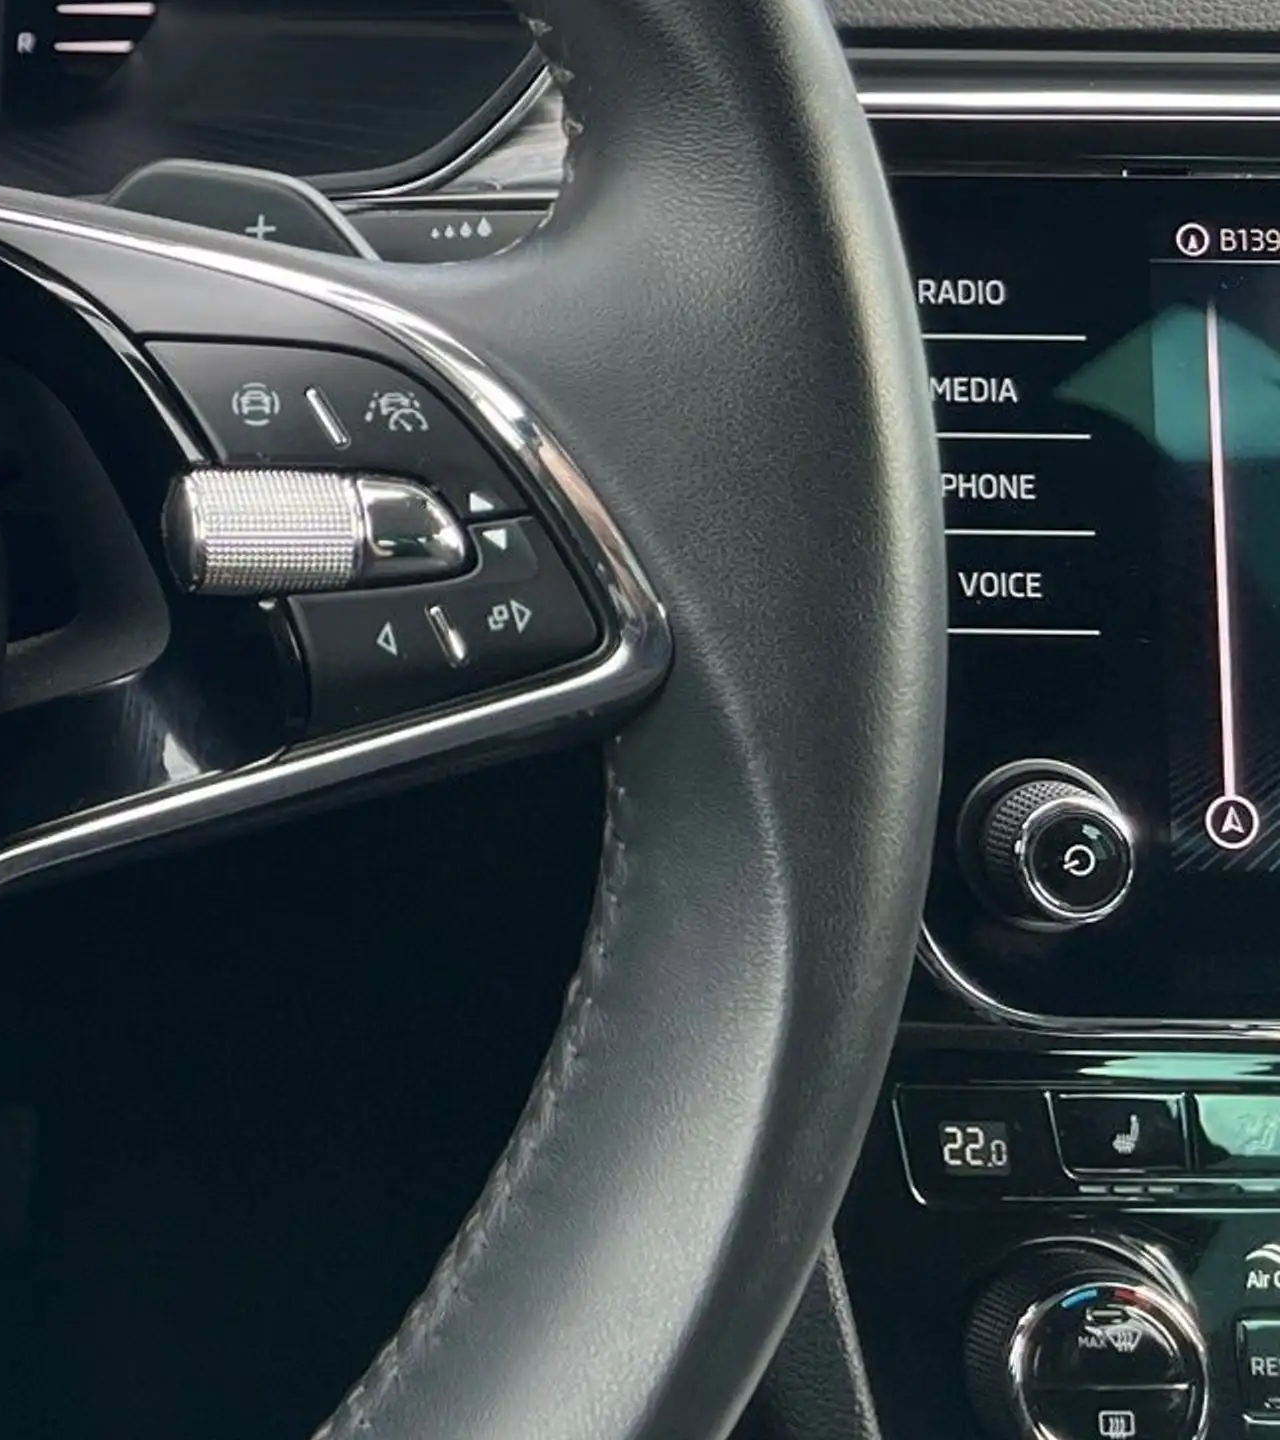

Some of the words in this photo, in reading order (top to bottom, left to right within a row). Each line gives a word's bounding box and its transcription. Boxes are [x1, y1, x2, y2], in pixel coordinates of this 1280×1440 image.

[16, 32, 37, 54] R
[1219, 227, 1280, 252] B139
[916, 278, 1007, 306] RADIO
[928, 376, 1019, 404] MEDIA
[940, 472, 1038, 500] PHONE
[957, 570, 1044, 599] VOICE
[942, 1125, 1008, 1168] 22.0
[1245, 1269, 1272, 1290] Air
[1077, 1334, 1107, 1350] MAX
